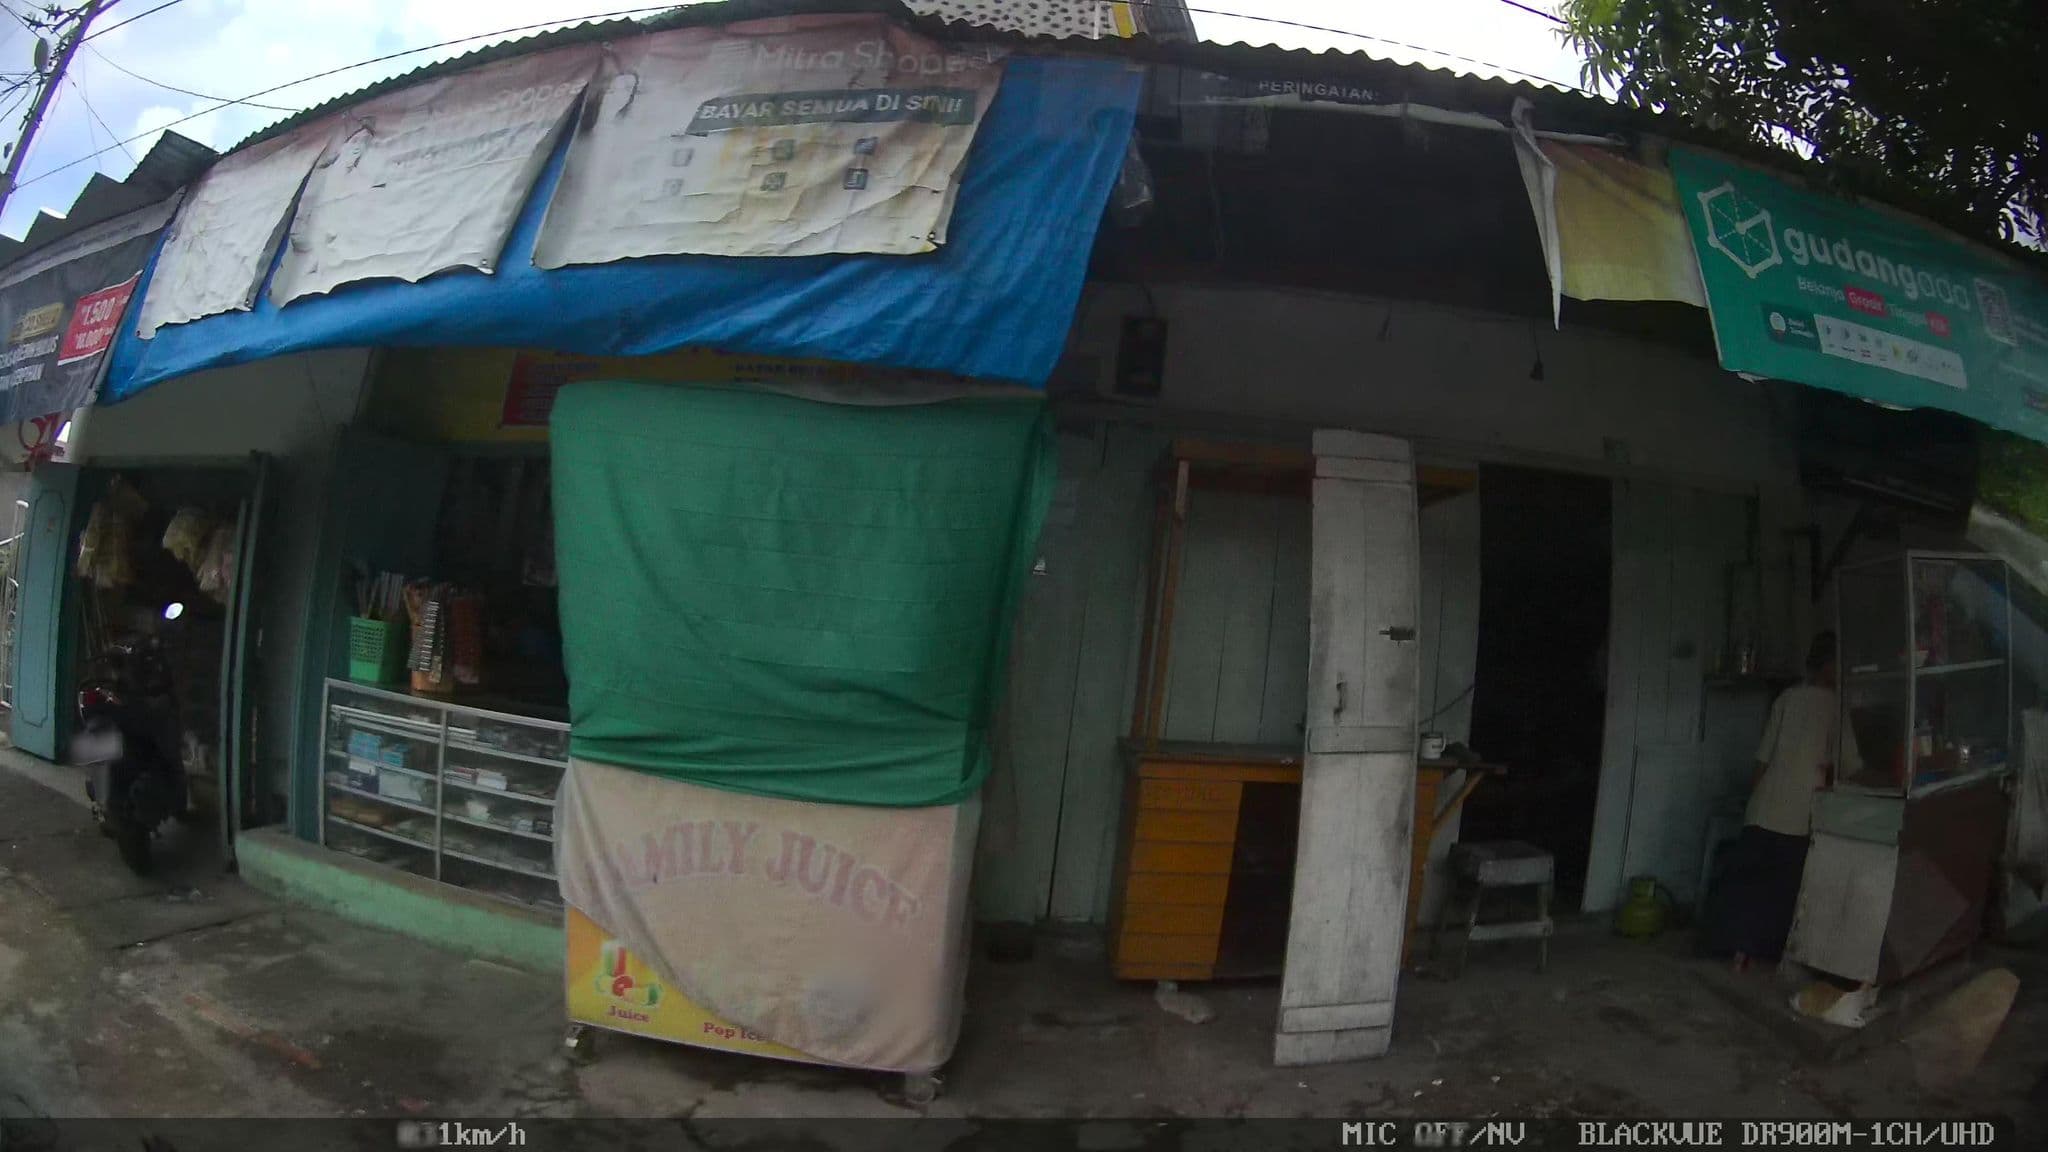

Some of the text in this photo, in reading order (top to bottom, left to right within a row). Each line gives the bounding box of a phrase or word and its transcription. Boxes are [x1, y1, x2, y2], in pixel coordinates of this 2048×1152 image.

[700, 101, 774, 119] BAYAR
[781, 100, 869, 115] SEMUA
[876, 94, 899, 111] DI
[703, 1021, 736, 1042] Pop
